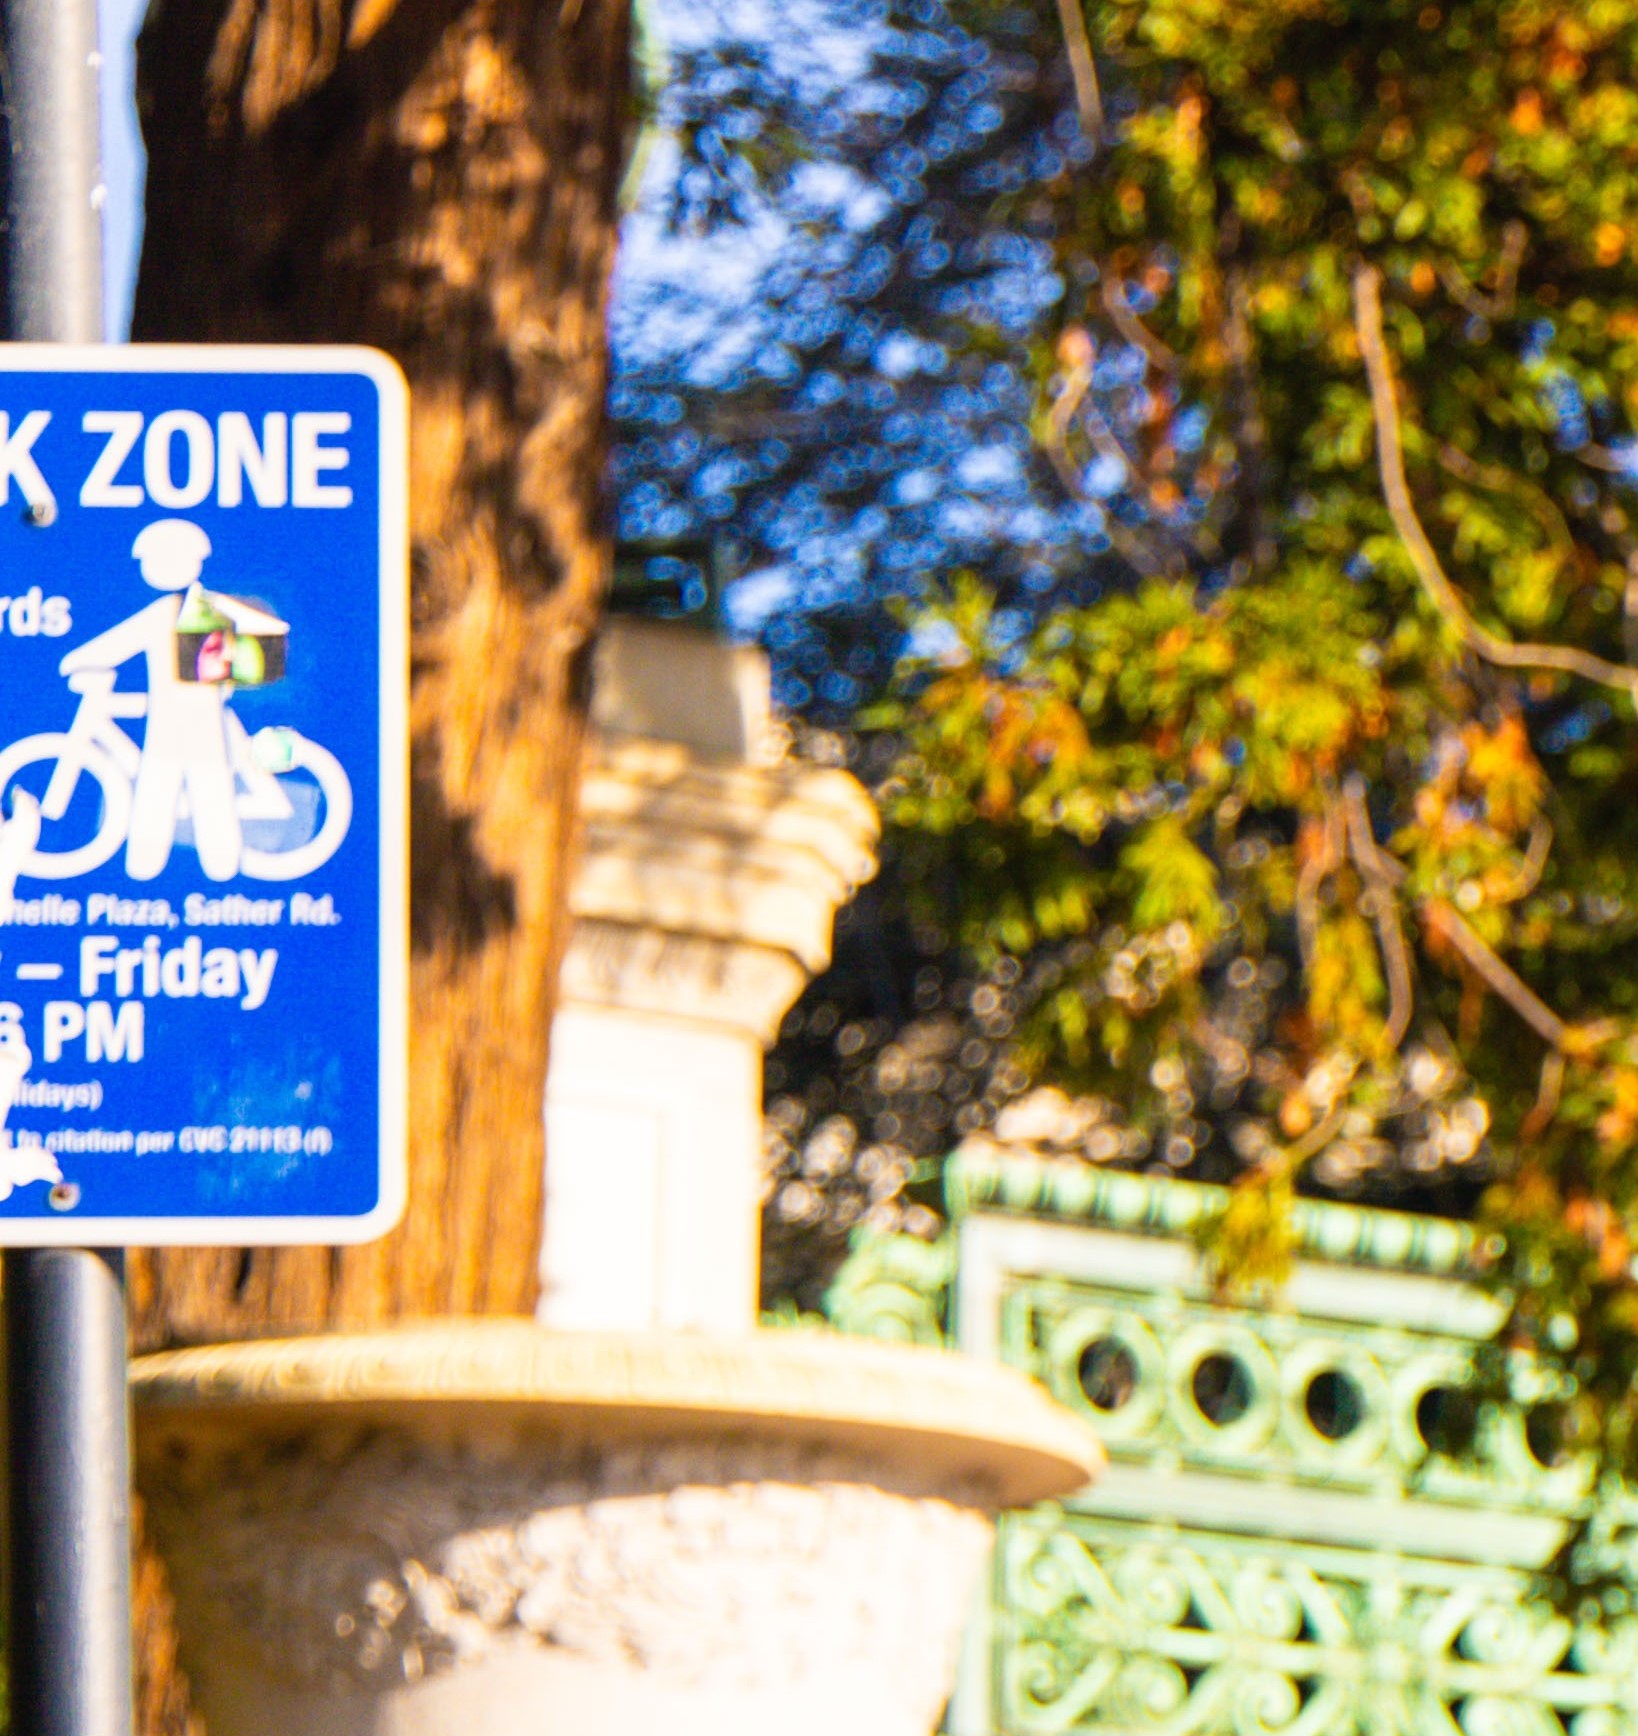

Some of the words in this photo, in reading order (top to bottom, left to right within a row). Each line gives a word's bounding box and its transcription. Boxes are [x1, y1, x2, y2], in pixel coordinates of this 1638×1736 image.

[80, 409, 353, 509] ZONE
[87, 892, 180, 930] Plaza,
[184, 892, 284, 926] Sather
[289, 892, 341, 926] Rd.
[80, 935, 279, 1011] Friday
[43, 1000, 145, 1063] PM
[135, 1130, 175, 1157] per
